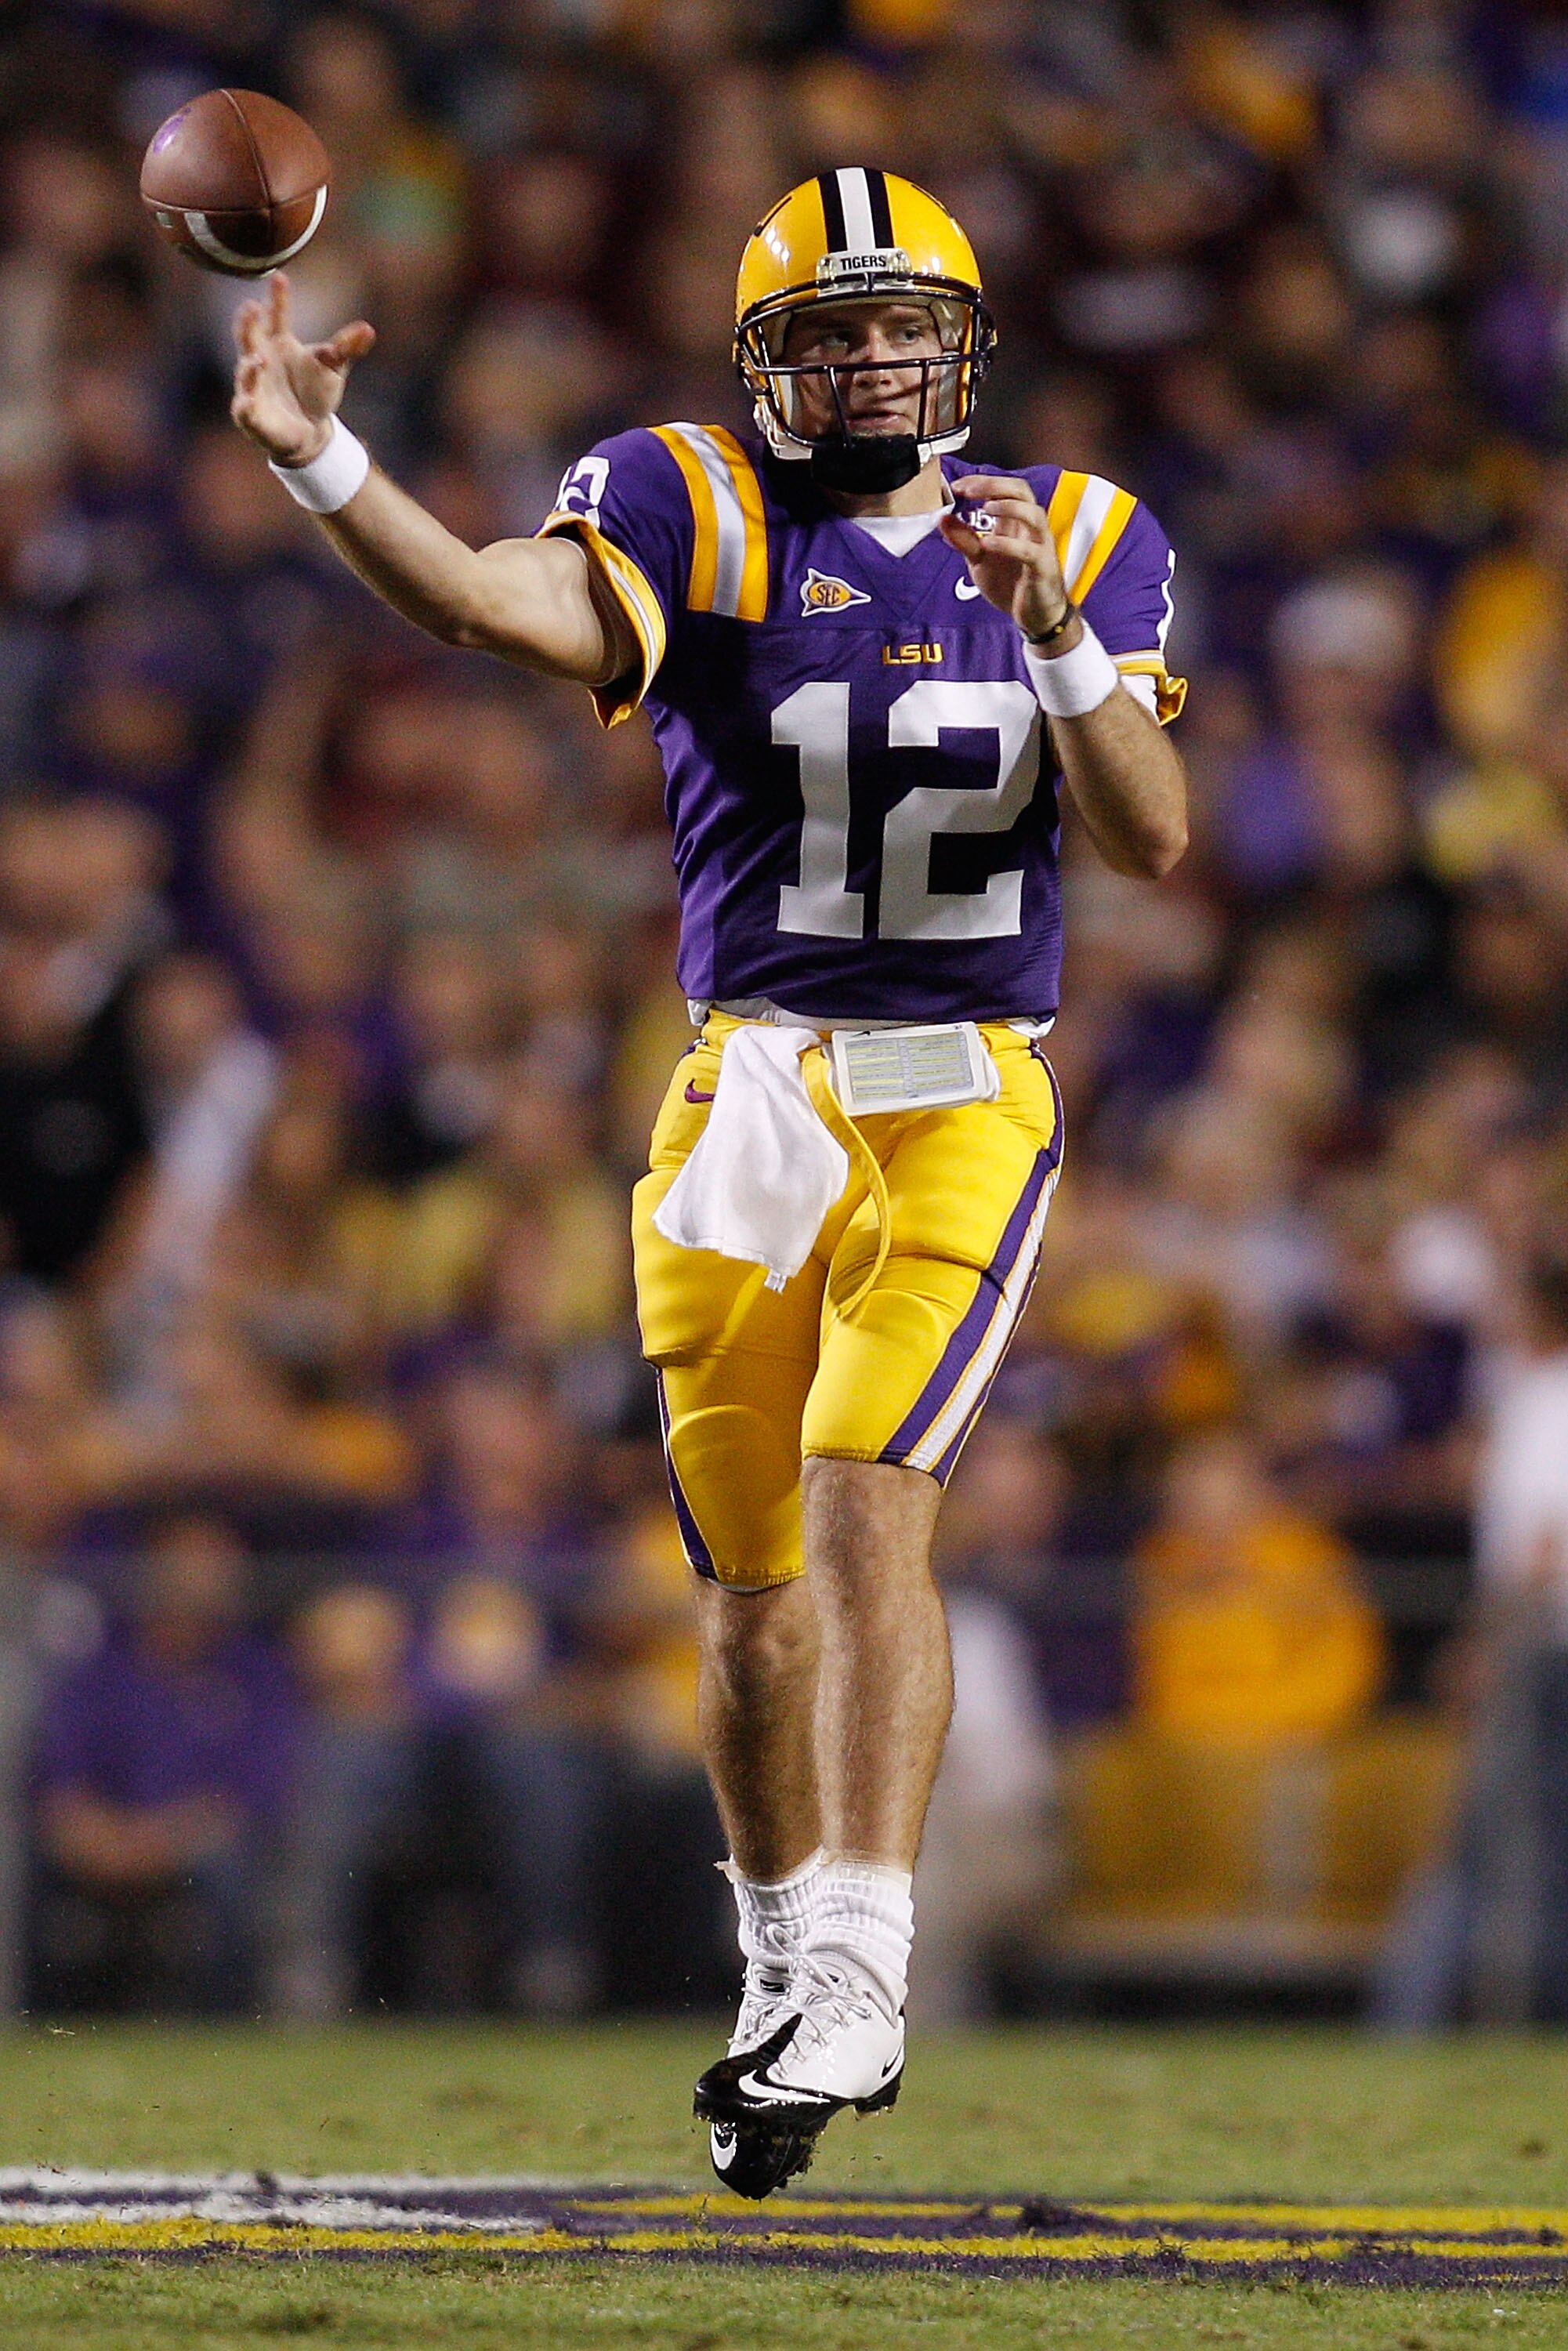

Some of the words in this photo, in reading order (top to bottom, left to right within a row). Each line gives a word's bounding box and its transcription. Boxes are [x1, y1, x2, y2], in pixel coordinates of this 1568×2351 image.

[841, 255, 886, 270] TIGERS
[552, 456, 610, 531] 2
[817, 584, 840, 605] SEC
[883, 643, 943, 665] LSU
[770, 680, 1041, 940] 12
